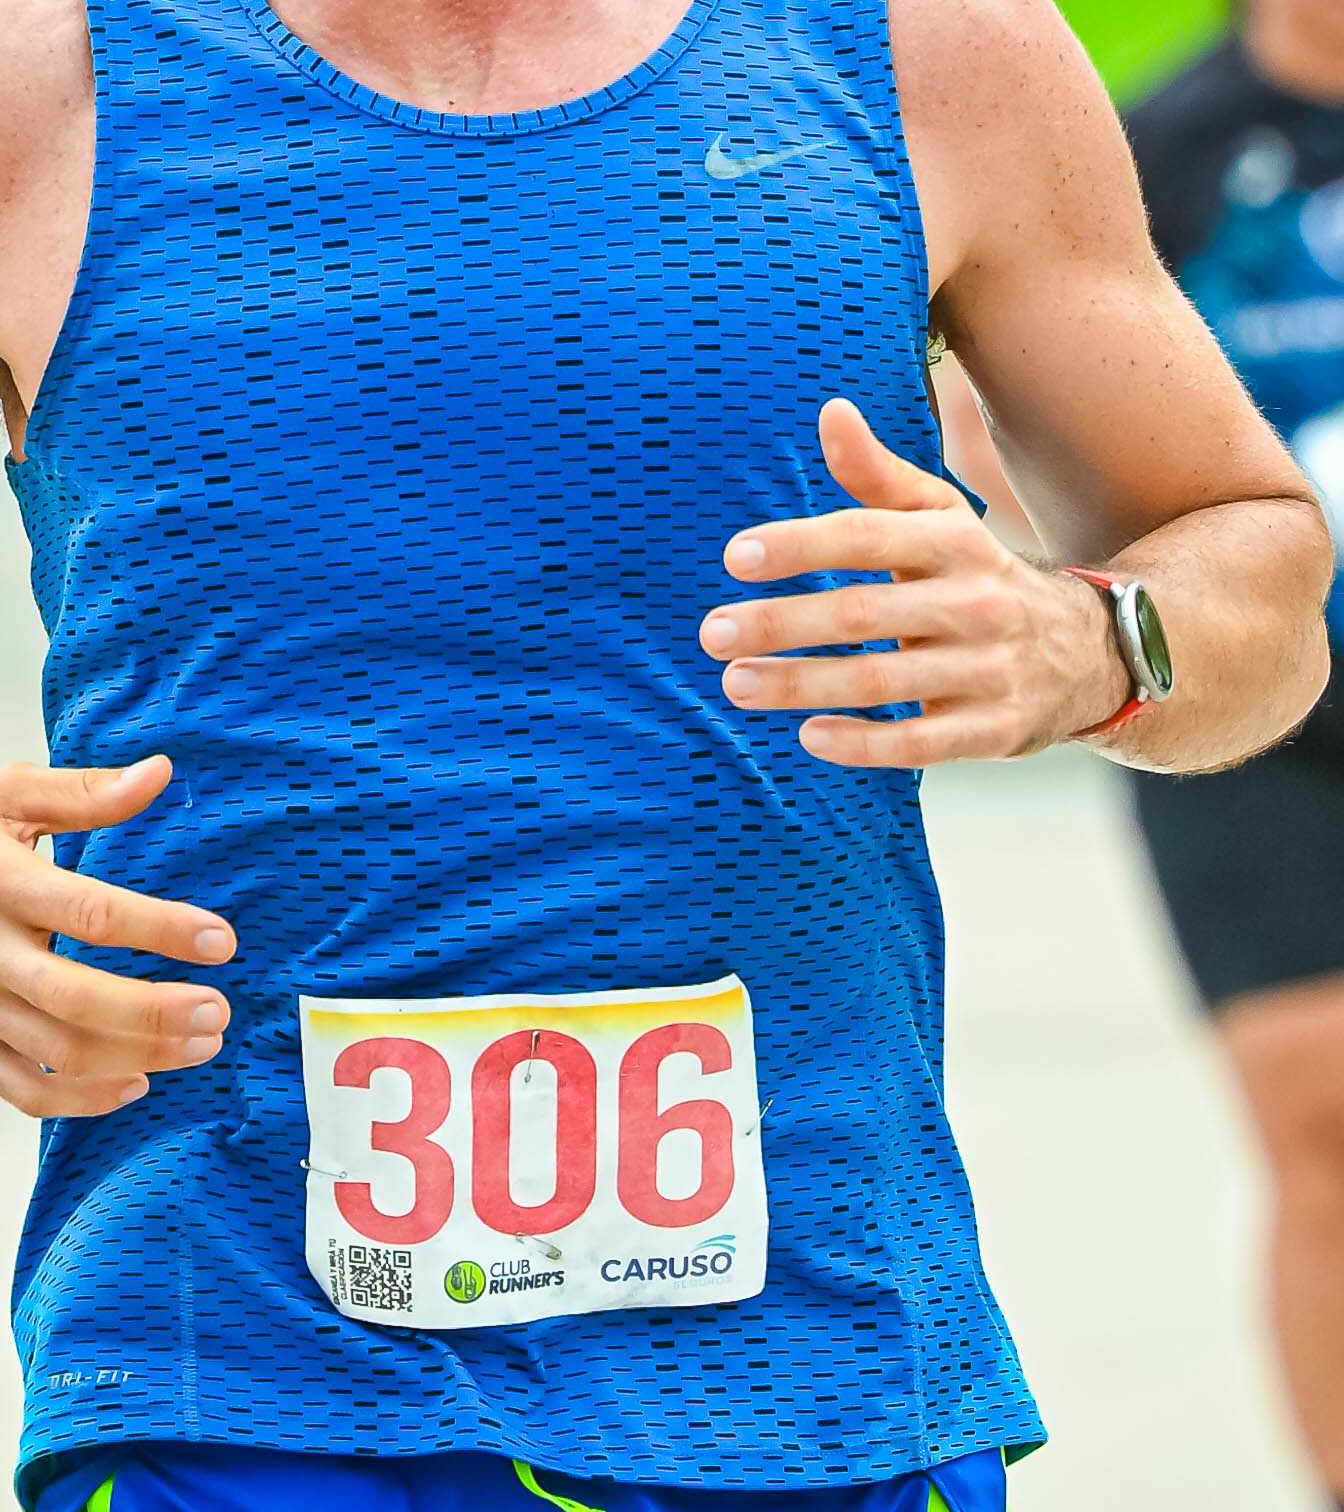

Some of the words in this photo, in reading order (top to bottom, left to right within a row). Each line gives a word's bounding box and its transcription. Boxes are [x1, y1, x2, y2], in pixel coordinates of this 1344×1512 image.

[333, 1022, 735, 1245] 306
[490, 1259, 531, 1278] CLUB
[600, 1251, 733, 1282] CARUSO
[489, 1270, 565, 1295] RUNNER'S
[48, 1369, 134, 1389] DRI-FIT
